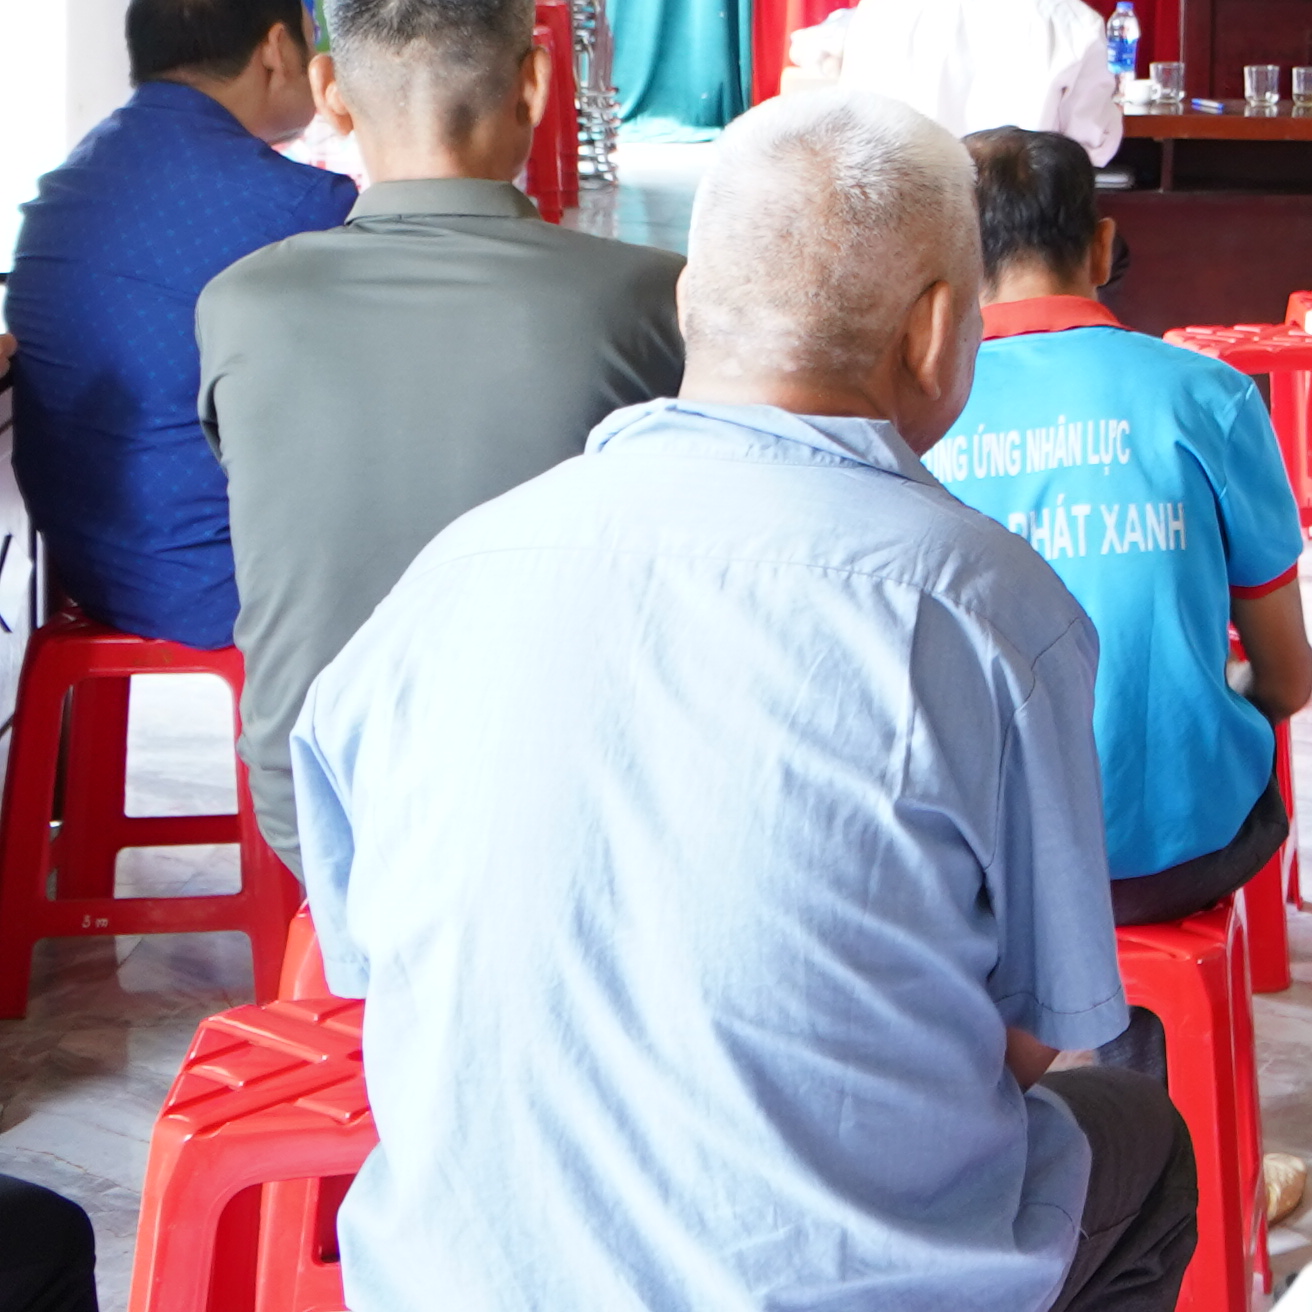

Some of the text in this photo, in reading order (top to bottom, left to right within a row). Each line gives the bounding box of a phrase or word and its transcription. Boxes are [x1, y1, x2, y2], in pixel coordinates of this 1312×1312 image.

[921, 414, 1130, 483] NG ỨNG NHÂN LỰC
[1100, 502, 1186, 555] XANH
